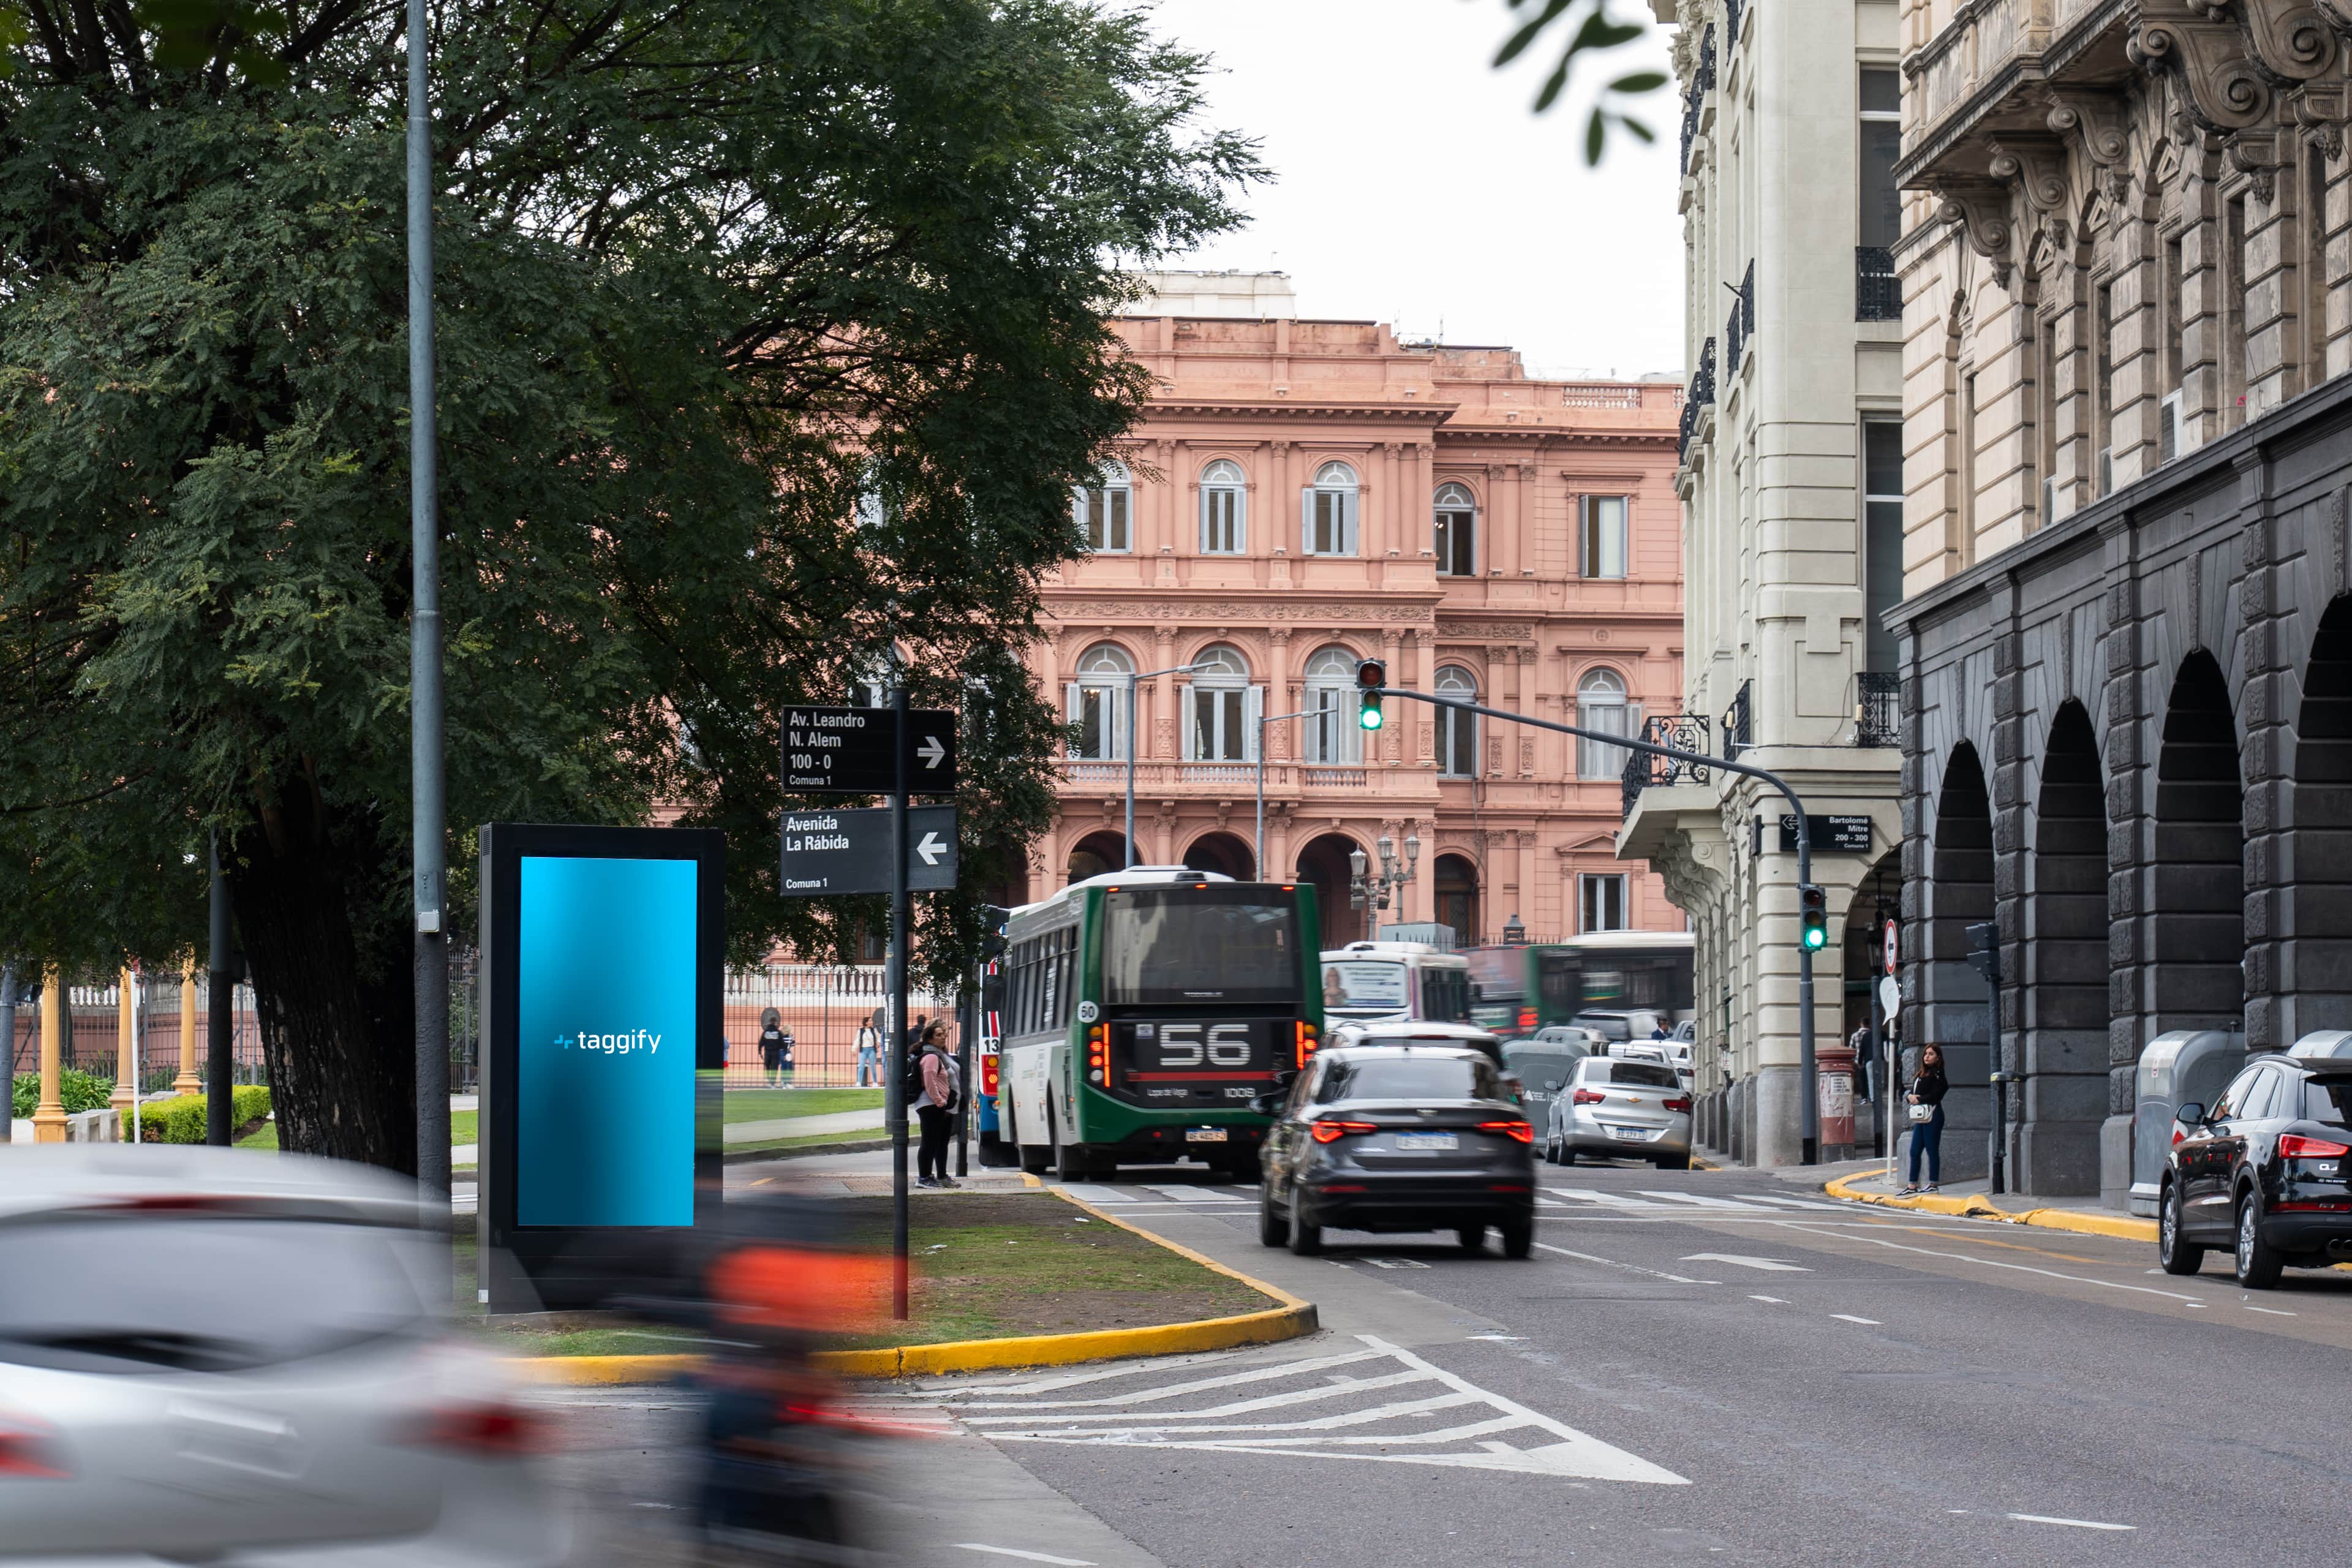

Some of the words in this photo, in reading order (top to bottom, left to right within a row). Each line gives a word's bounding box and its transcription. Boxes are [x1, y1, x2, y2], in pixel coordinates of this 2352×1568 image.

[790, 711, 809, 726] Av.
[813, 712, 865, 727] Leandro
[790, 732, 804, 746] N.
[808, 732, 841, 747] Alem
[791, 755, 812, 769] 100
[824, 755, 831, 769] 0
[790, 775, 824, 785] Comuna
[826, 775, 831, 785] 1
[786, 815, 837, 832] Avenida
[786, 837, 801, 851] La
[805, 834, 849, 851] Rábida
[786, 878, 821, 889] Comuna
[823, 878, 827, 887] 1
[1081, 1006, 1095, 1018] 60
[578, 1029, 662, 1054] taggify
[1159, 1024, 1251, 1066] 56
[1224, 1087, 1256, 1097] 1008
